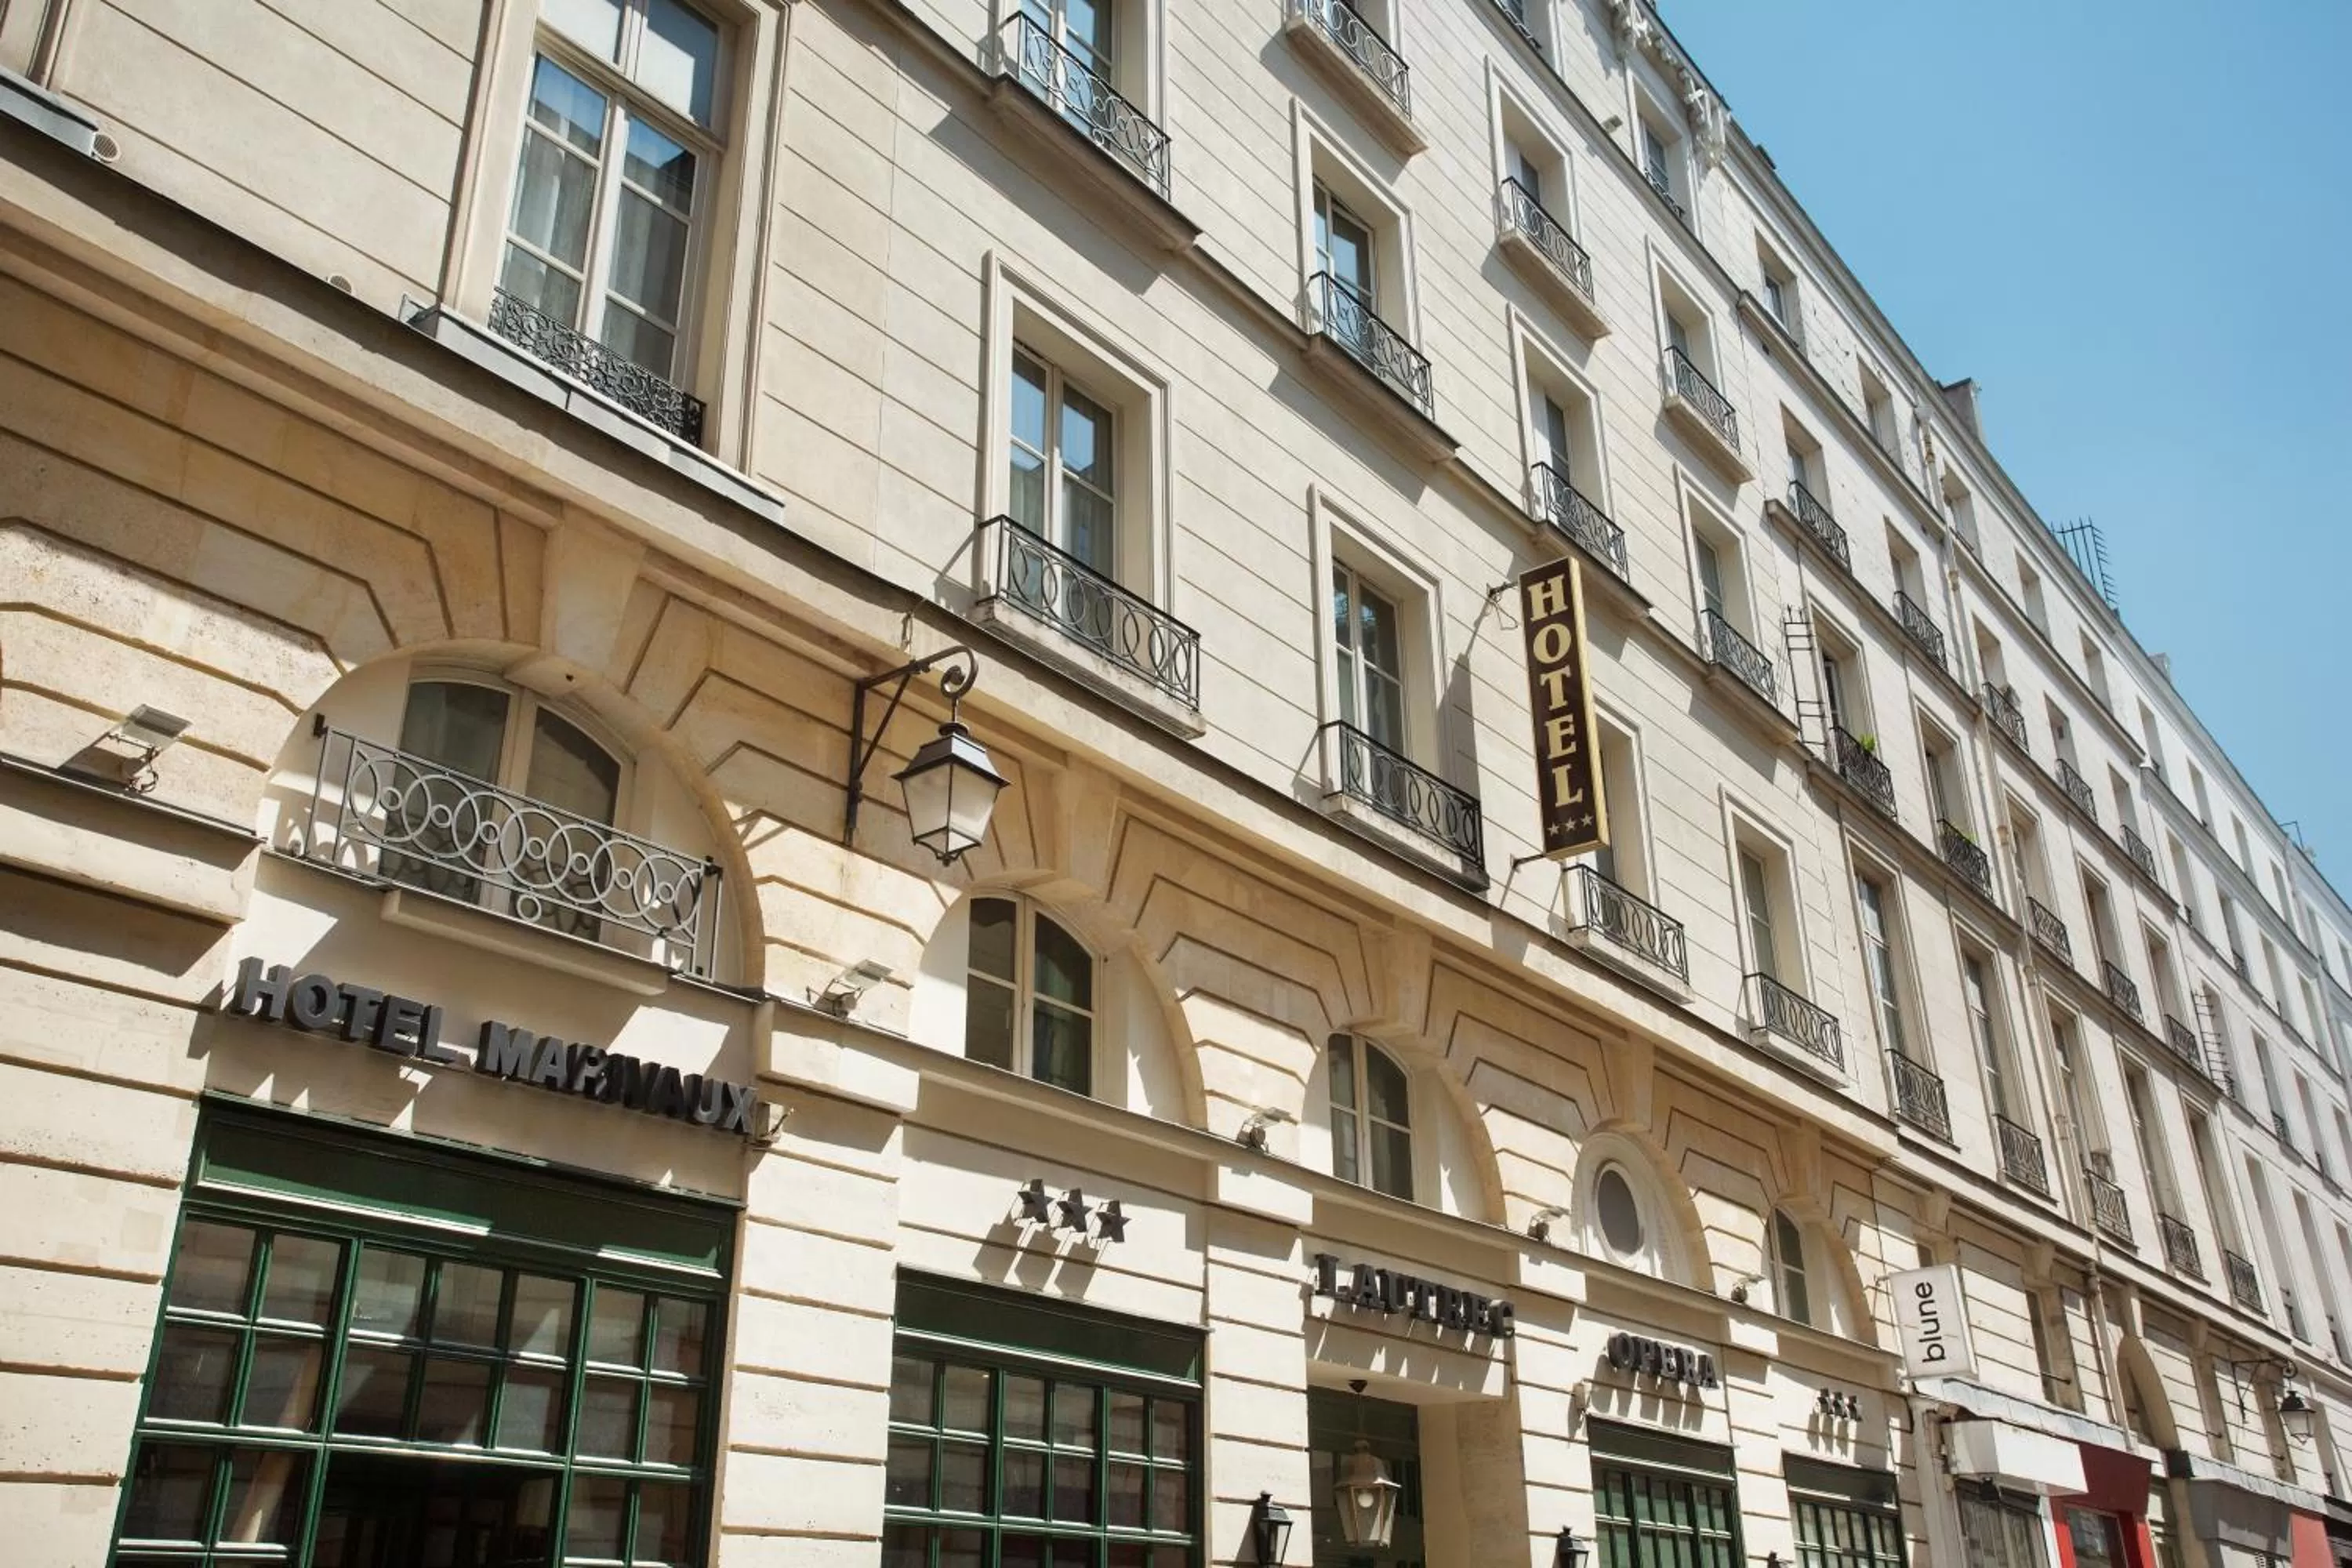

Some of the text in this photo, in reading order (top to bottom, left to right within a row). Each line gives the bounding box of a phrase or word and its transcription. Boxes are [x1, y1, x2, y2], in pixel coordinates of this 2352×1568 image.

[1527, 573, 1583, 808] HOTEL
[233, 956, 759, 1136] HOTEL MARIVAUX
[1315, 1254, 1515, 1338] LAUTREC
[1915, 1281, 1947, 1363] blune
[1608, 1332, 1719, 1388] OPERA
